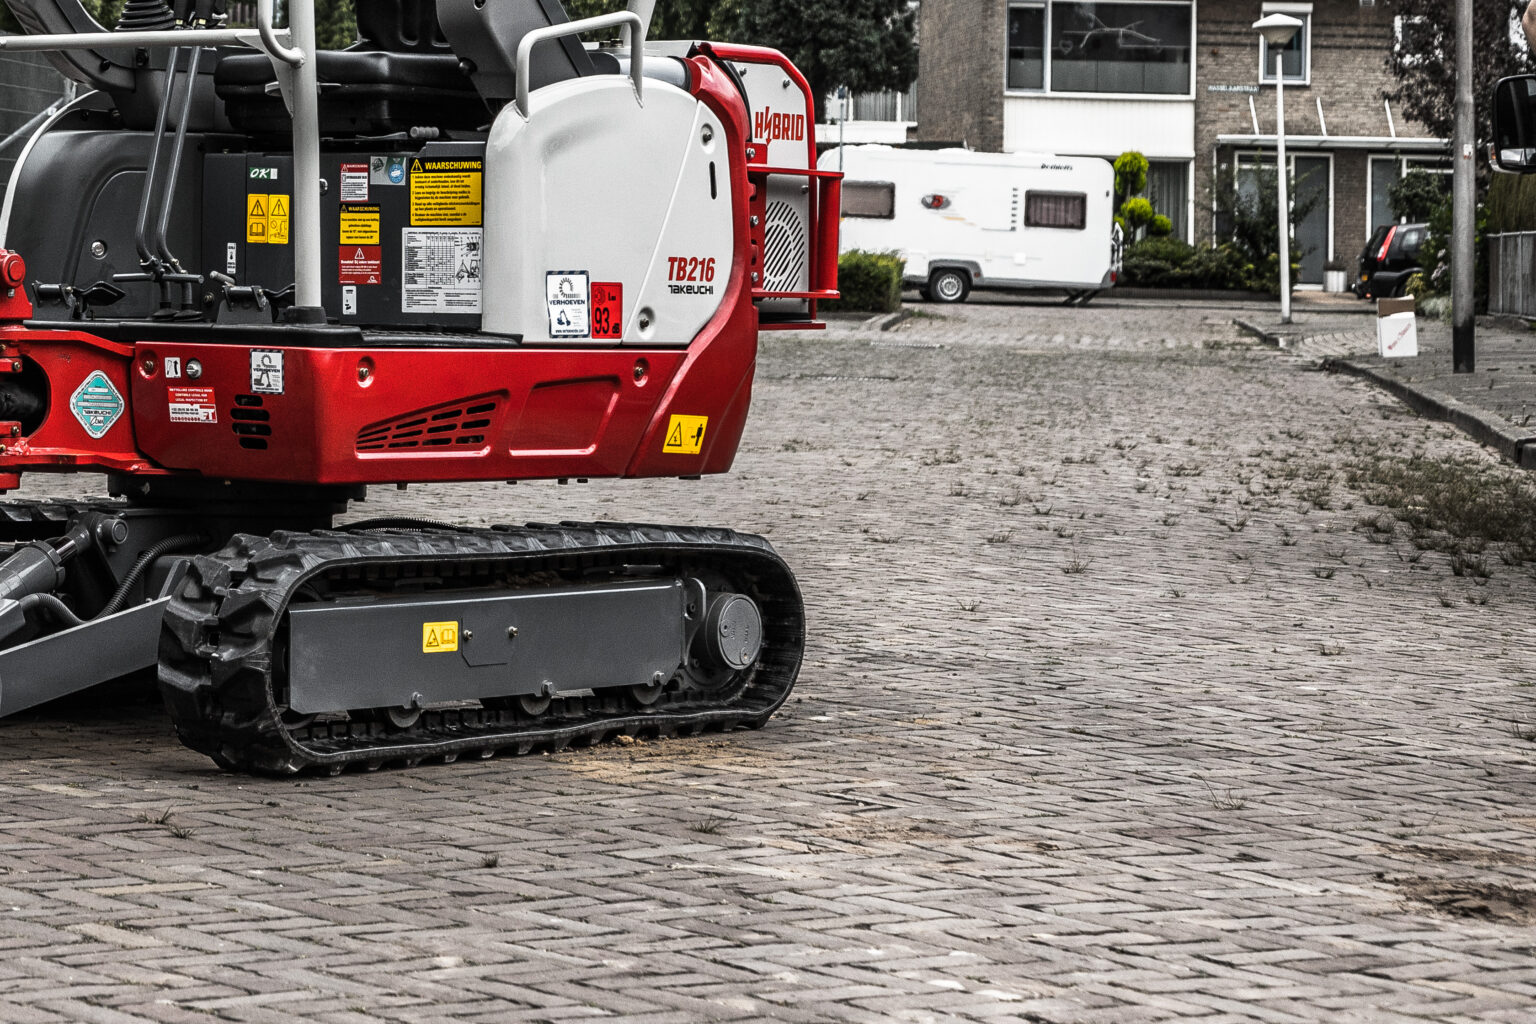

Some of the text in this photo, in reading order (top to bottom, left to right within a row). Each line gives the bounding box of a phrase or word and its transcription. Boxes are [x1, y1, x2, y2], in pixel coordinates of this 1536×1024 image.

[754, 106, 804, 145] HYBRID
[249, 168, 270, 179] OK
[425, 161, 482, 170] WAARSCHUWING
[668, 257, 715, 282] TB216
[594, 307, 610, 335] 93
